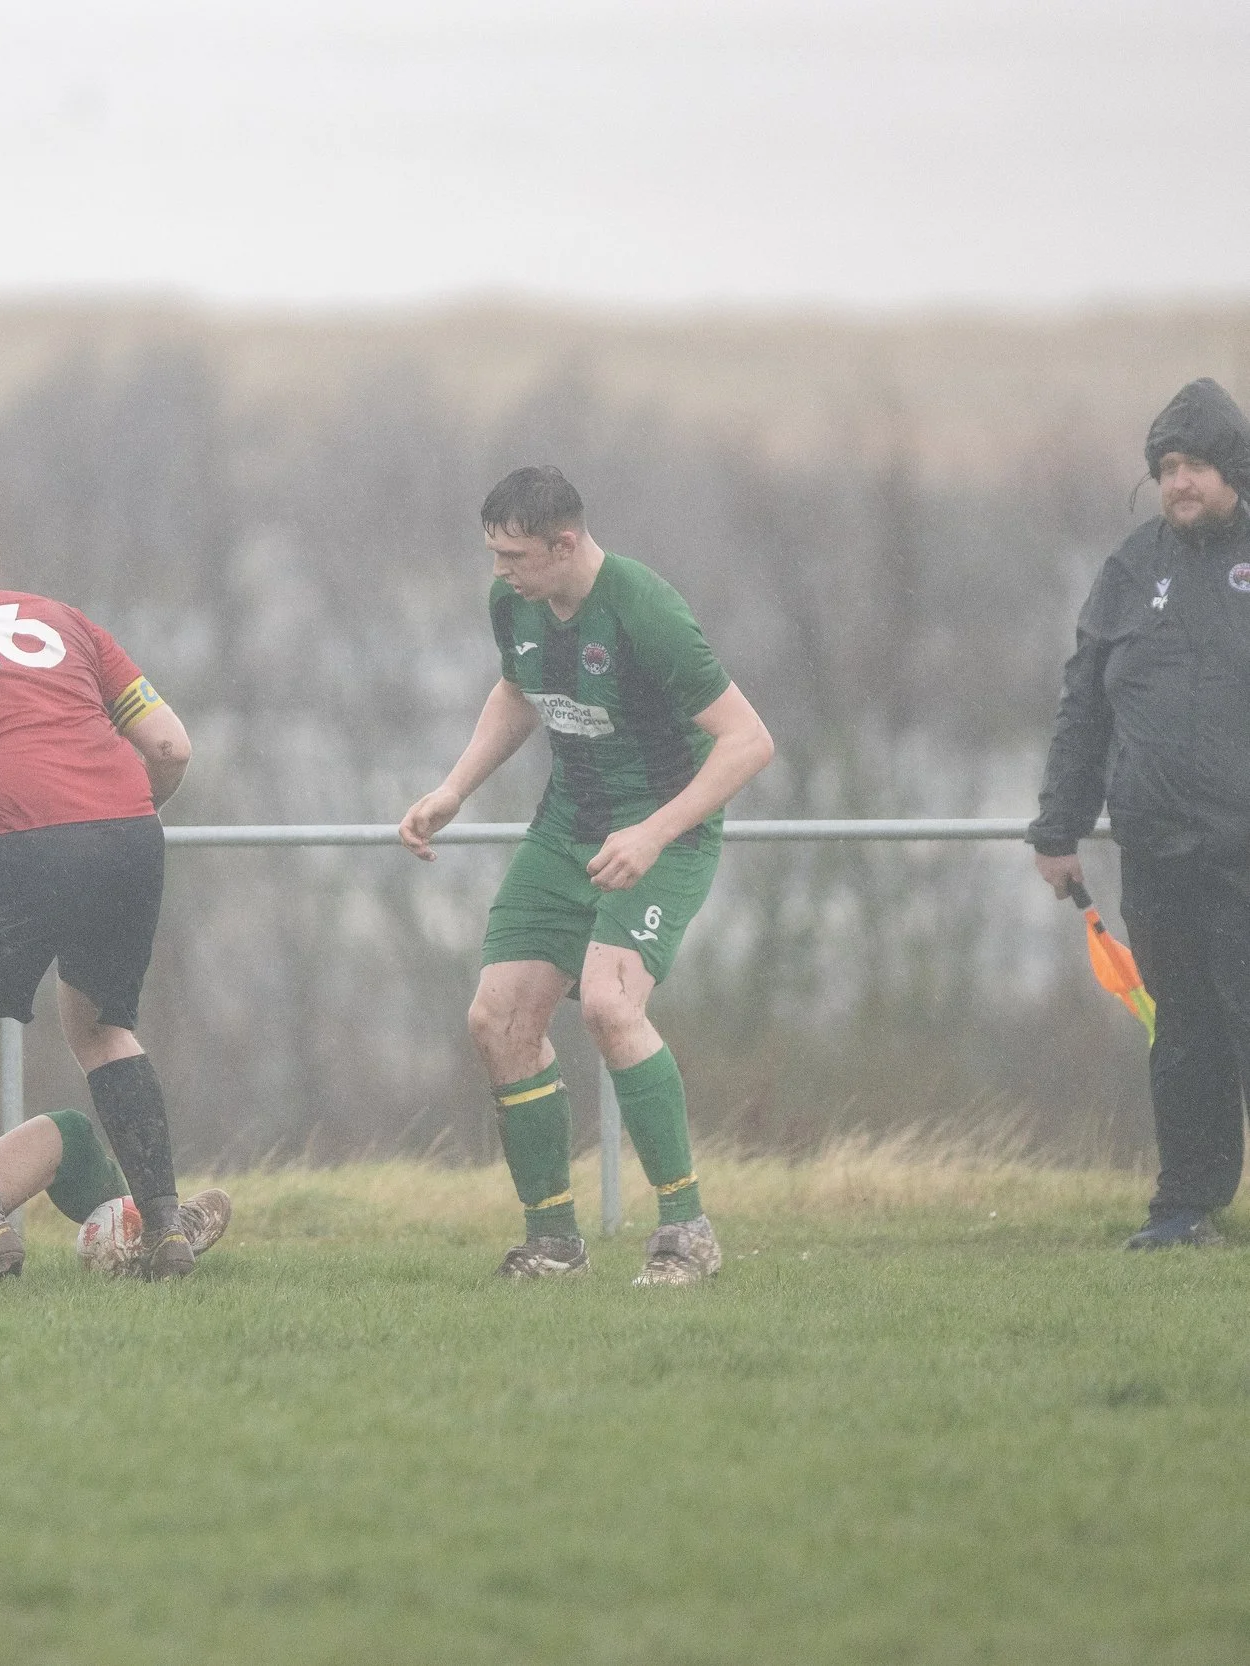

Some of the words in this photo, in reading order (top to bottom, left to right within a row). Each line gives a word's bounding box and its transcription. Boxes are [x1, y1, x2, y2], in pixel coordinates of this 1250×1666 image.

[140, 680, 159, 703] C
[542, 697, 591, 717] Lakend
[645, 905, 662, 929] 6
